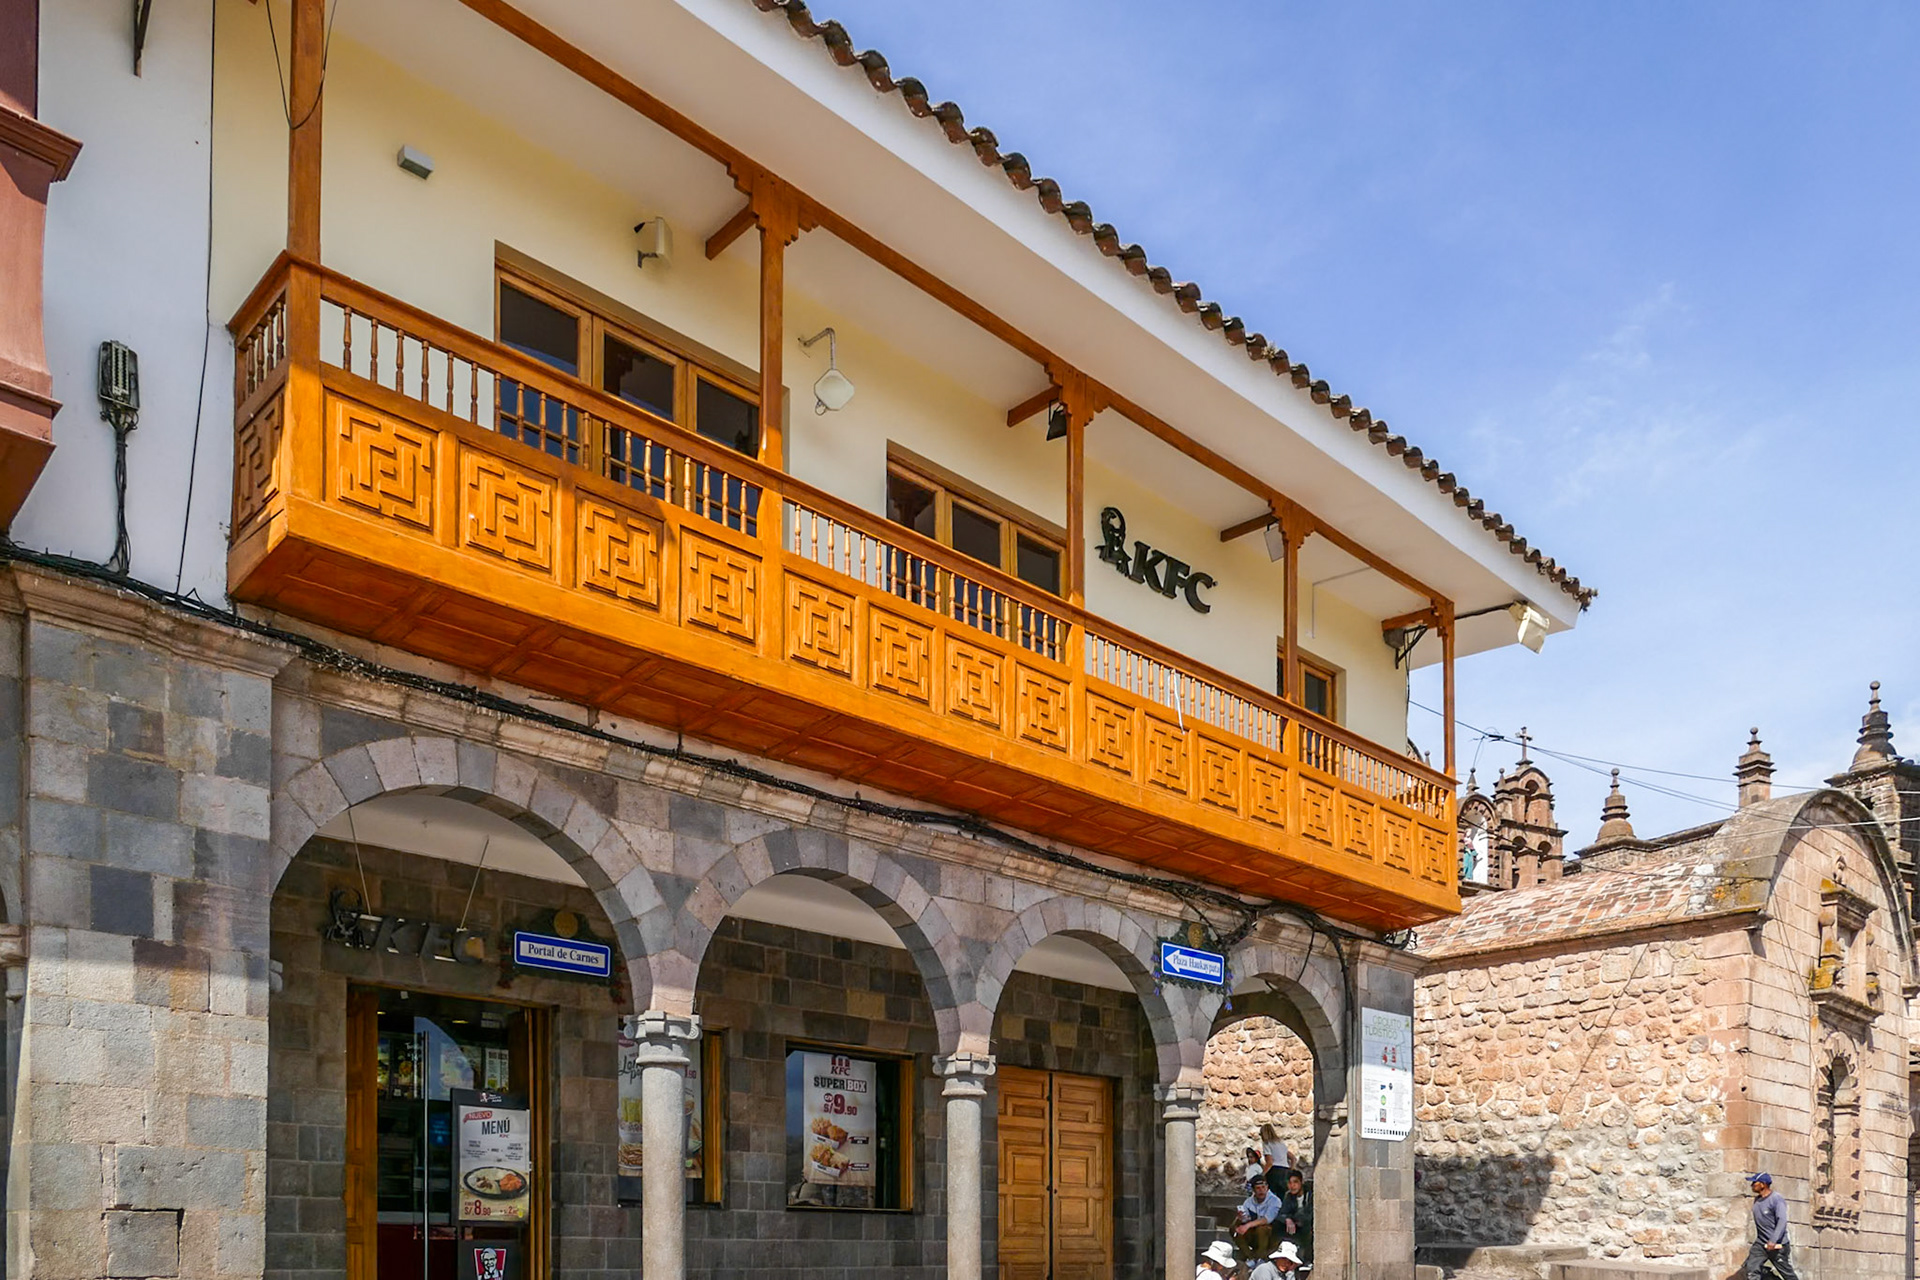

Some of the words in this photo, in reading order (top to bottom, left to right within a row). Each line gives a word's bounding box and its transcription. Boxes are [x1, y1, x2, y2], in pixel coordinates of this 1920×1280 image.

[1128, 540, 1214, 614] KFC
[528, 943, 555, 958] Portal
[557, 948, 568, 959] de
[569, 949, 599, 964] Carnes
[1173, 954, 1188, 967] Plaza
[830, 1066, 851, 1076] KFC
[814, 1076, 845, 1090] SUPER
[847, 1080, 867, 1093] BOX
[468, 1111, 492, 1119] NUEVO
[481, 1117, 510, 1135] MENÚ
